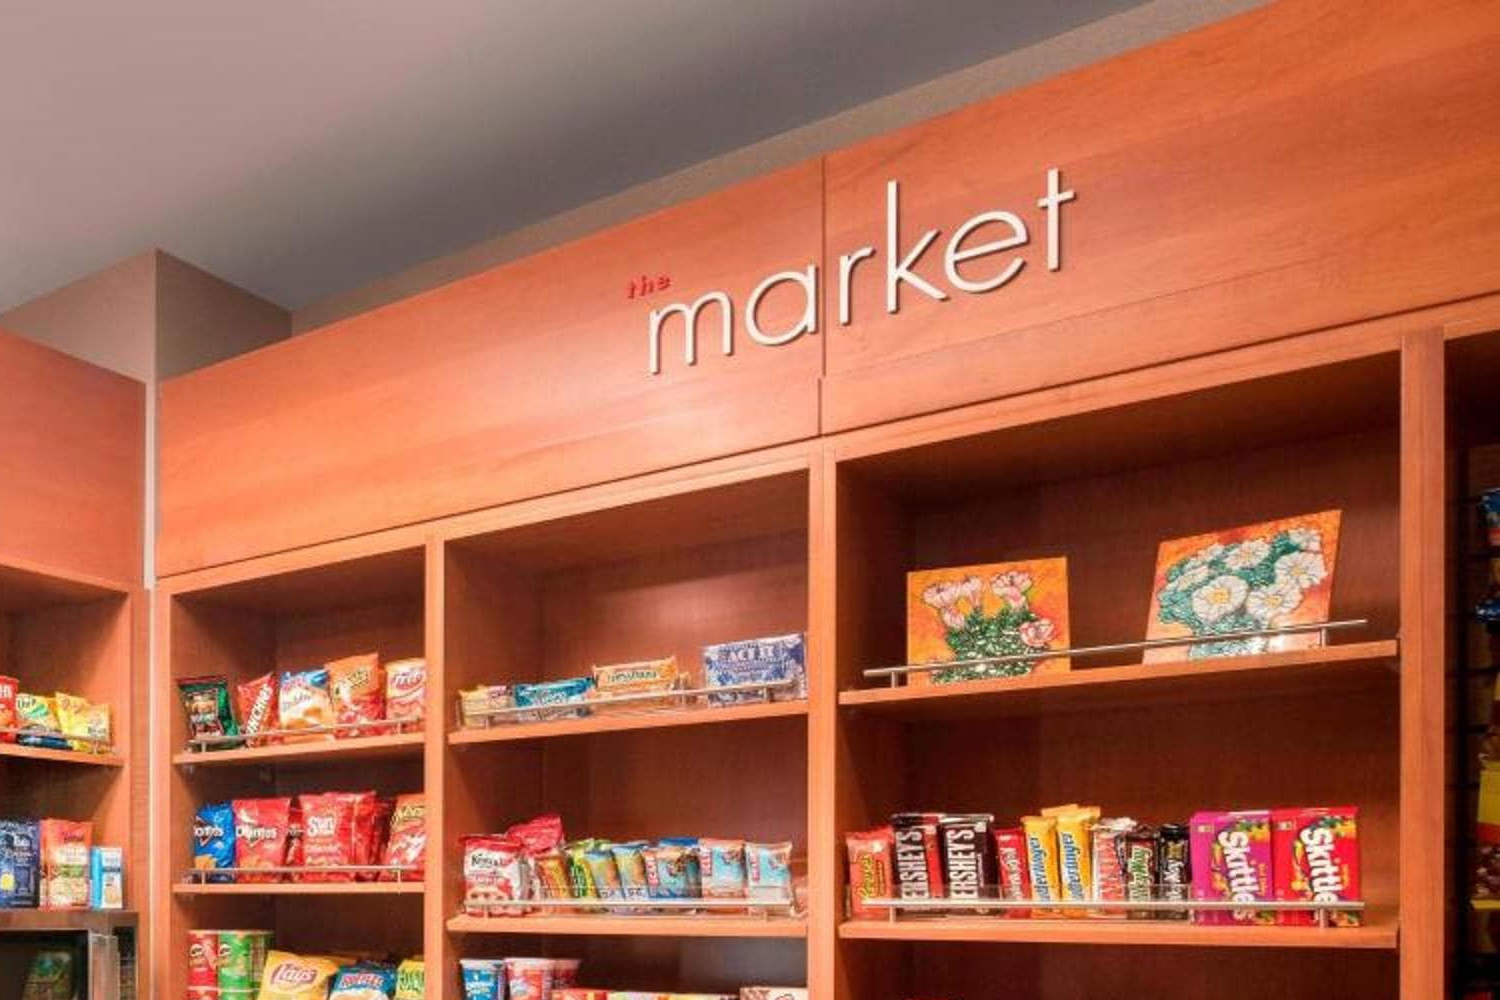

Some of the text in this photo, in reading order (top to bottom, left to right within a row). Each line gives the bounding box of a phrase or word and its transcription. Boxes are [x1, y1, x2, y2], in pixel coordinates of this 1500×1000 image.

[627, 275, 672, 299] the
[649, 168, 1076, 375] market
[897, 830, 930, 899] ERSHEY'S
[946, 828, 978, 899] ERSHEY'S
[1217, 830, 1261, 919] Skittles
[1300, 827, 1342, 904] Skittle
[273, 962, 317, 984] Lay's
